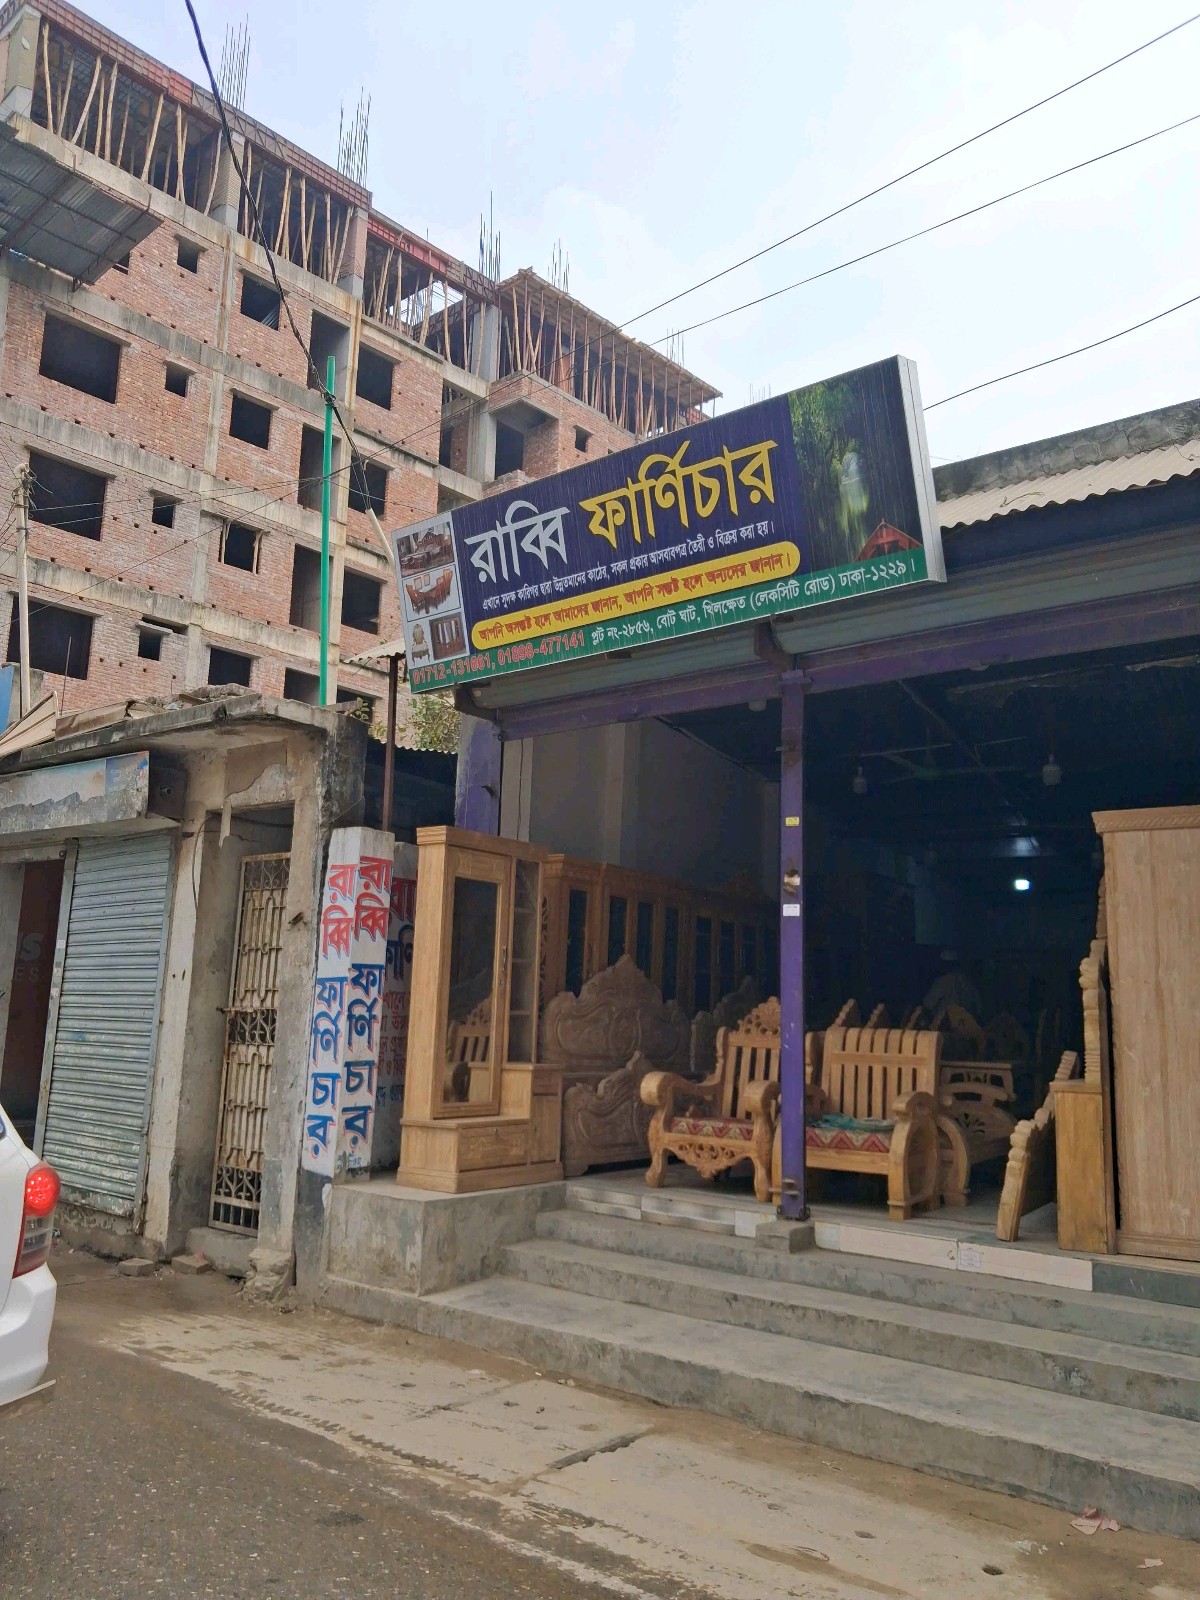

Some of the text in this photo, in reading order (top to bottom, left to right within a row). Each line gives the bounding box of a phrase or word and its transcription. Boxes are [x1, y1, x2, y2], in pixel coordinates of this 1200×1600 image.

[464, 440, 778, 583] রাব্বি ফার্ণিচার
[478, 622, 504, 641] আপনি
[533, 612, 551, 630] হলে
[552, 603, 589, 623] আমাদের
[623, 584, 654, 606] আপনি
[681, 573, 703, 592] হলে
[704, 562, 748, 584] অন্যদের
[483, 595, 501, 610] এখানে
[517, 583, 539, 602] কারিগর
[553, 576, 586, 592] উন্নতমানের
[611, 560, 628, 575] সকল
[629, 555, 648, 571] প্রকার
[649, 542, 687, 565] আসবাবপত্র
[687, 534, 706, 554] তৈরী
[707, 538, 714, 549] ও
[715, 528, 738, 549] বিক্রয়
[739, 525, 755, 540] করা
[656, 613, 676, 629] বোট
[702, 601, 746, 620] খিলক্ষেত
